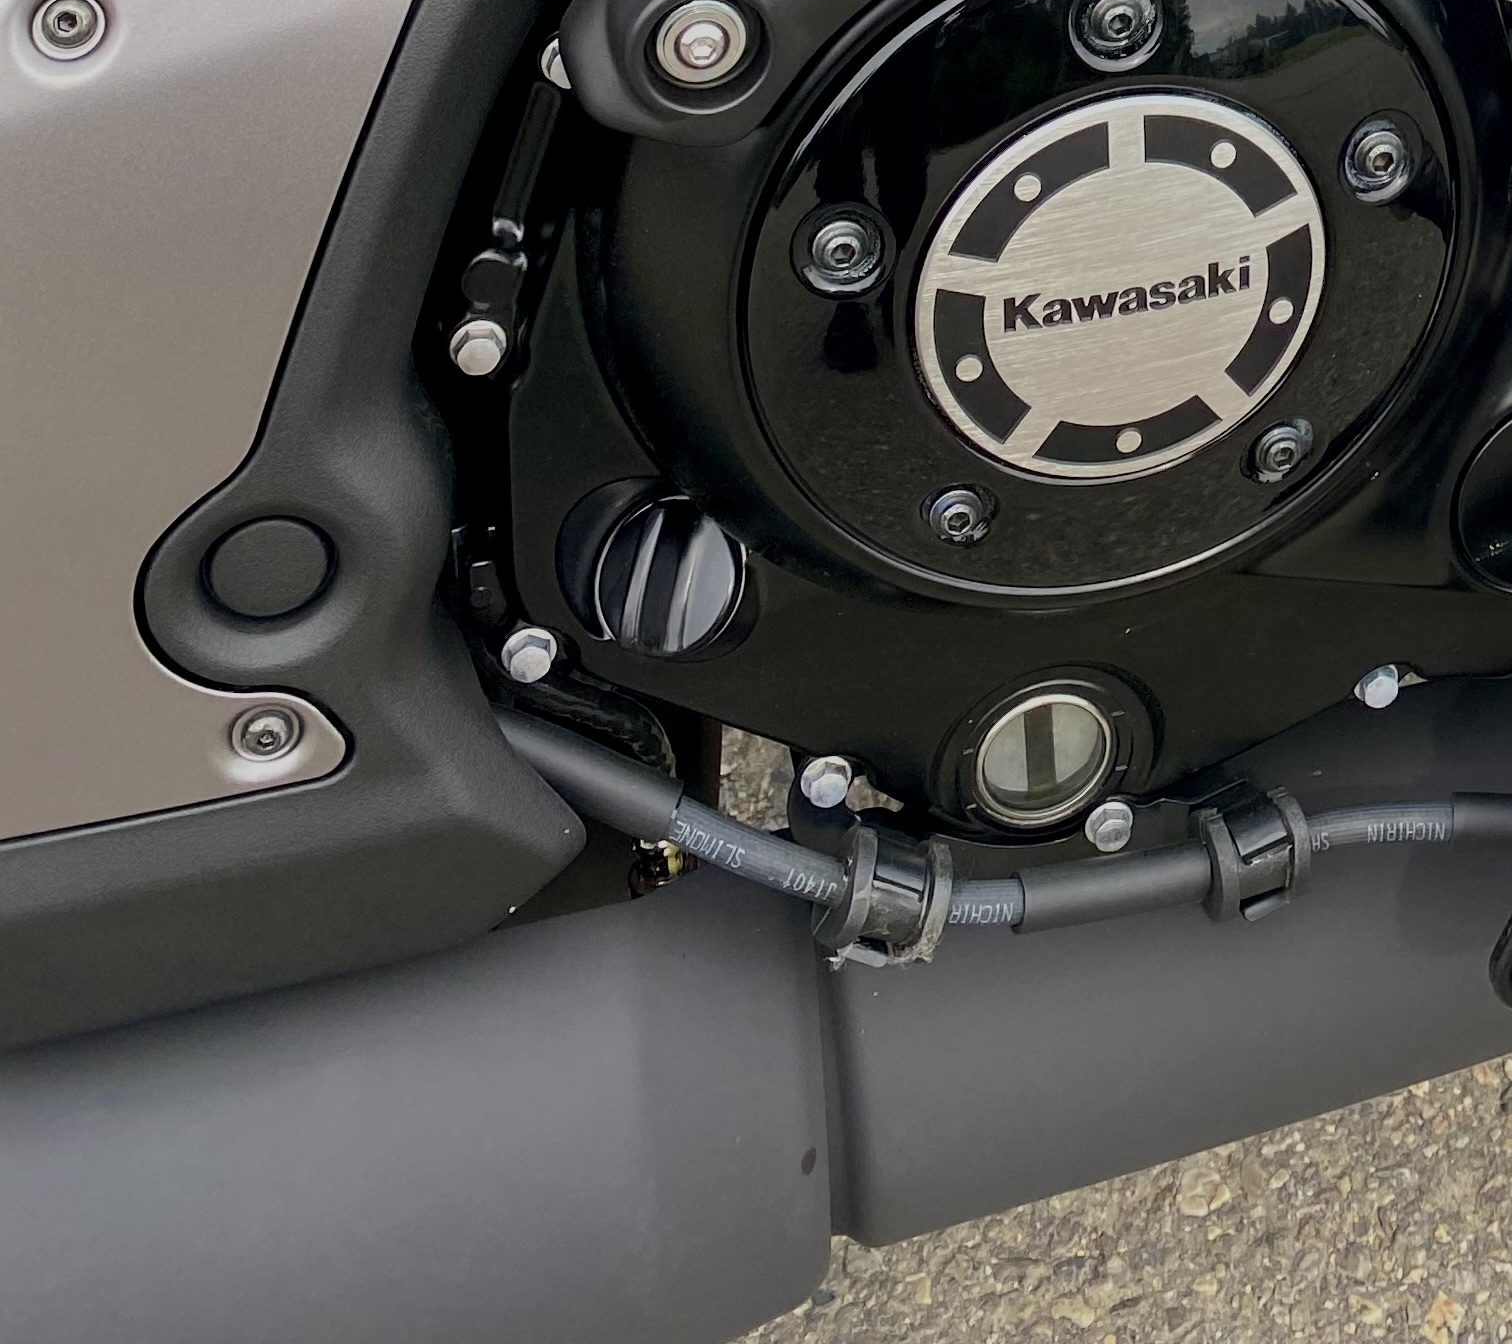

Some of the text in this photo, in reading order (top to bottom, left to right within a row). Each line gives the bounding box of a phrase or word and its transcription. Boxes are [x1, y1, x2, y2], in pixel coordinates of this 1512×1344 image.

[1003, 255, 1252, 334] Kawasaki
[669, 820, 838, 901] J1401 SLIMONE
[1312, 821, 1446, 853] NICHIRIN SA
[949, 902, 1014, 924] NICHIR
